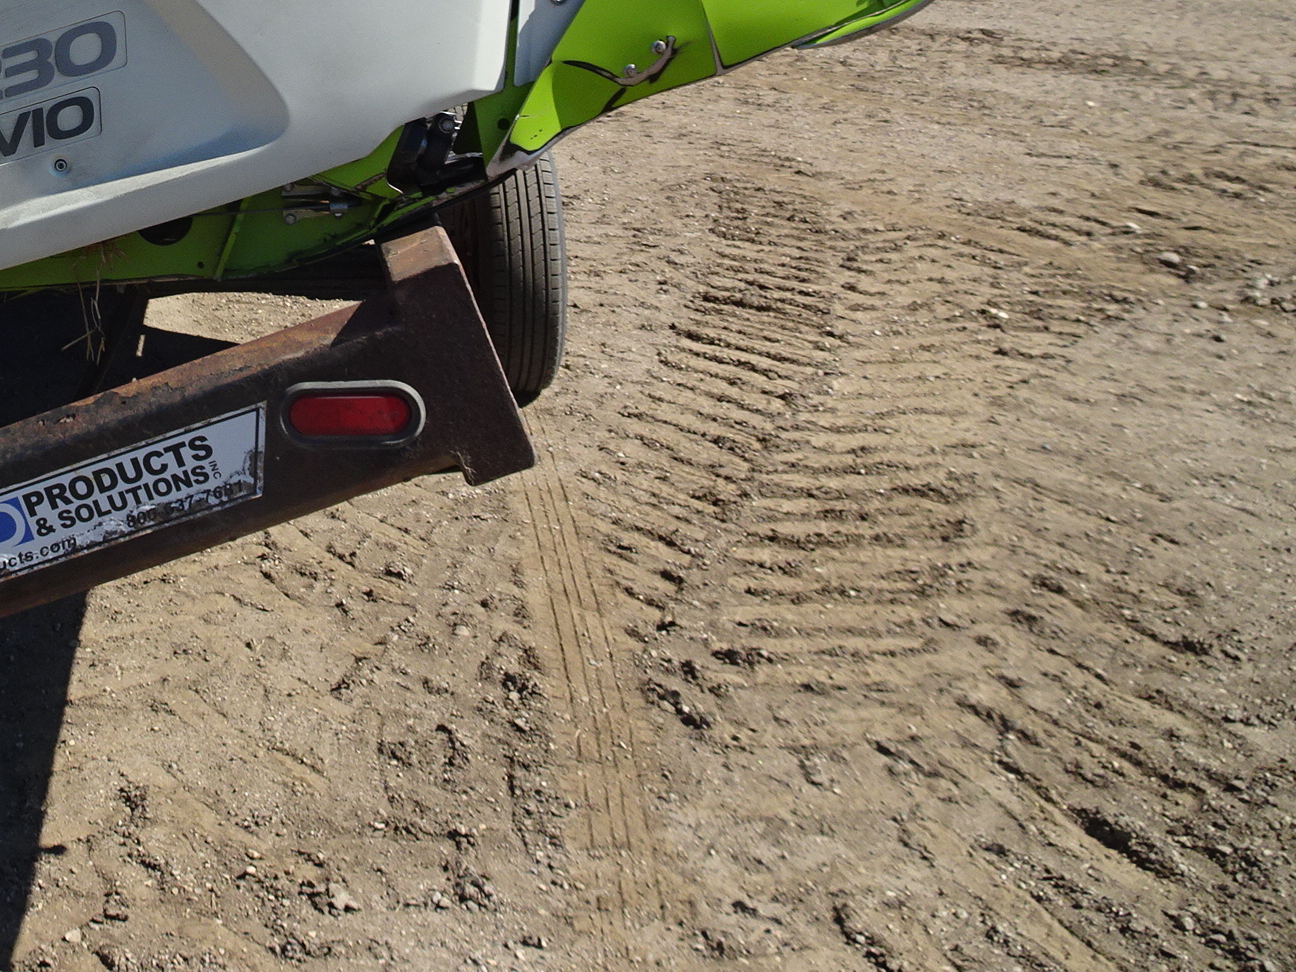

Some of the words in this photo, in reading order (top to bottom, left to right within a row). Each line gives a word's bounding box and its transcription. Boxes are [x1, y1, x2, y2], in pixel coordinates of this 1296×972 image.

[22, 435, 213, 517] PRODUCTS
[35, 517, 57, 538] &
[59, 464, 210, 530] SOLUTIONS
[209, 460, 222, 480] INC
